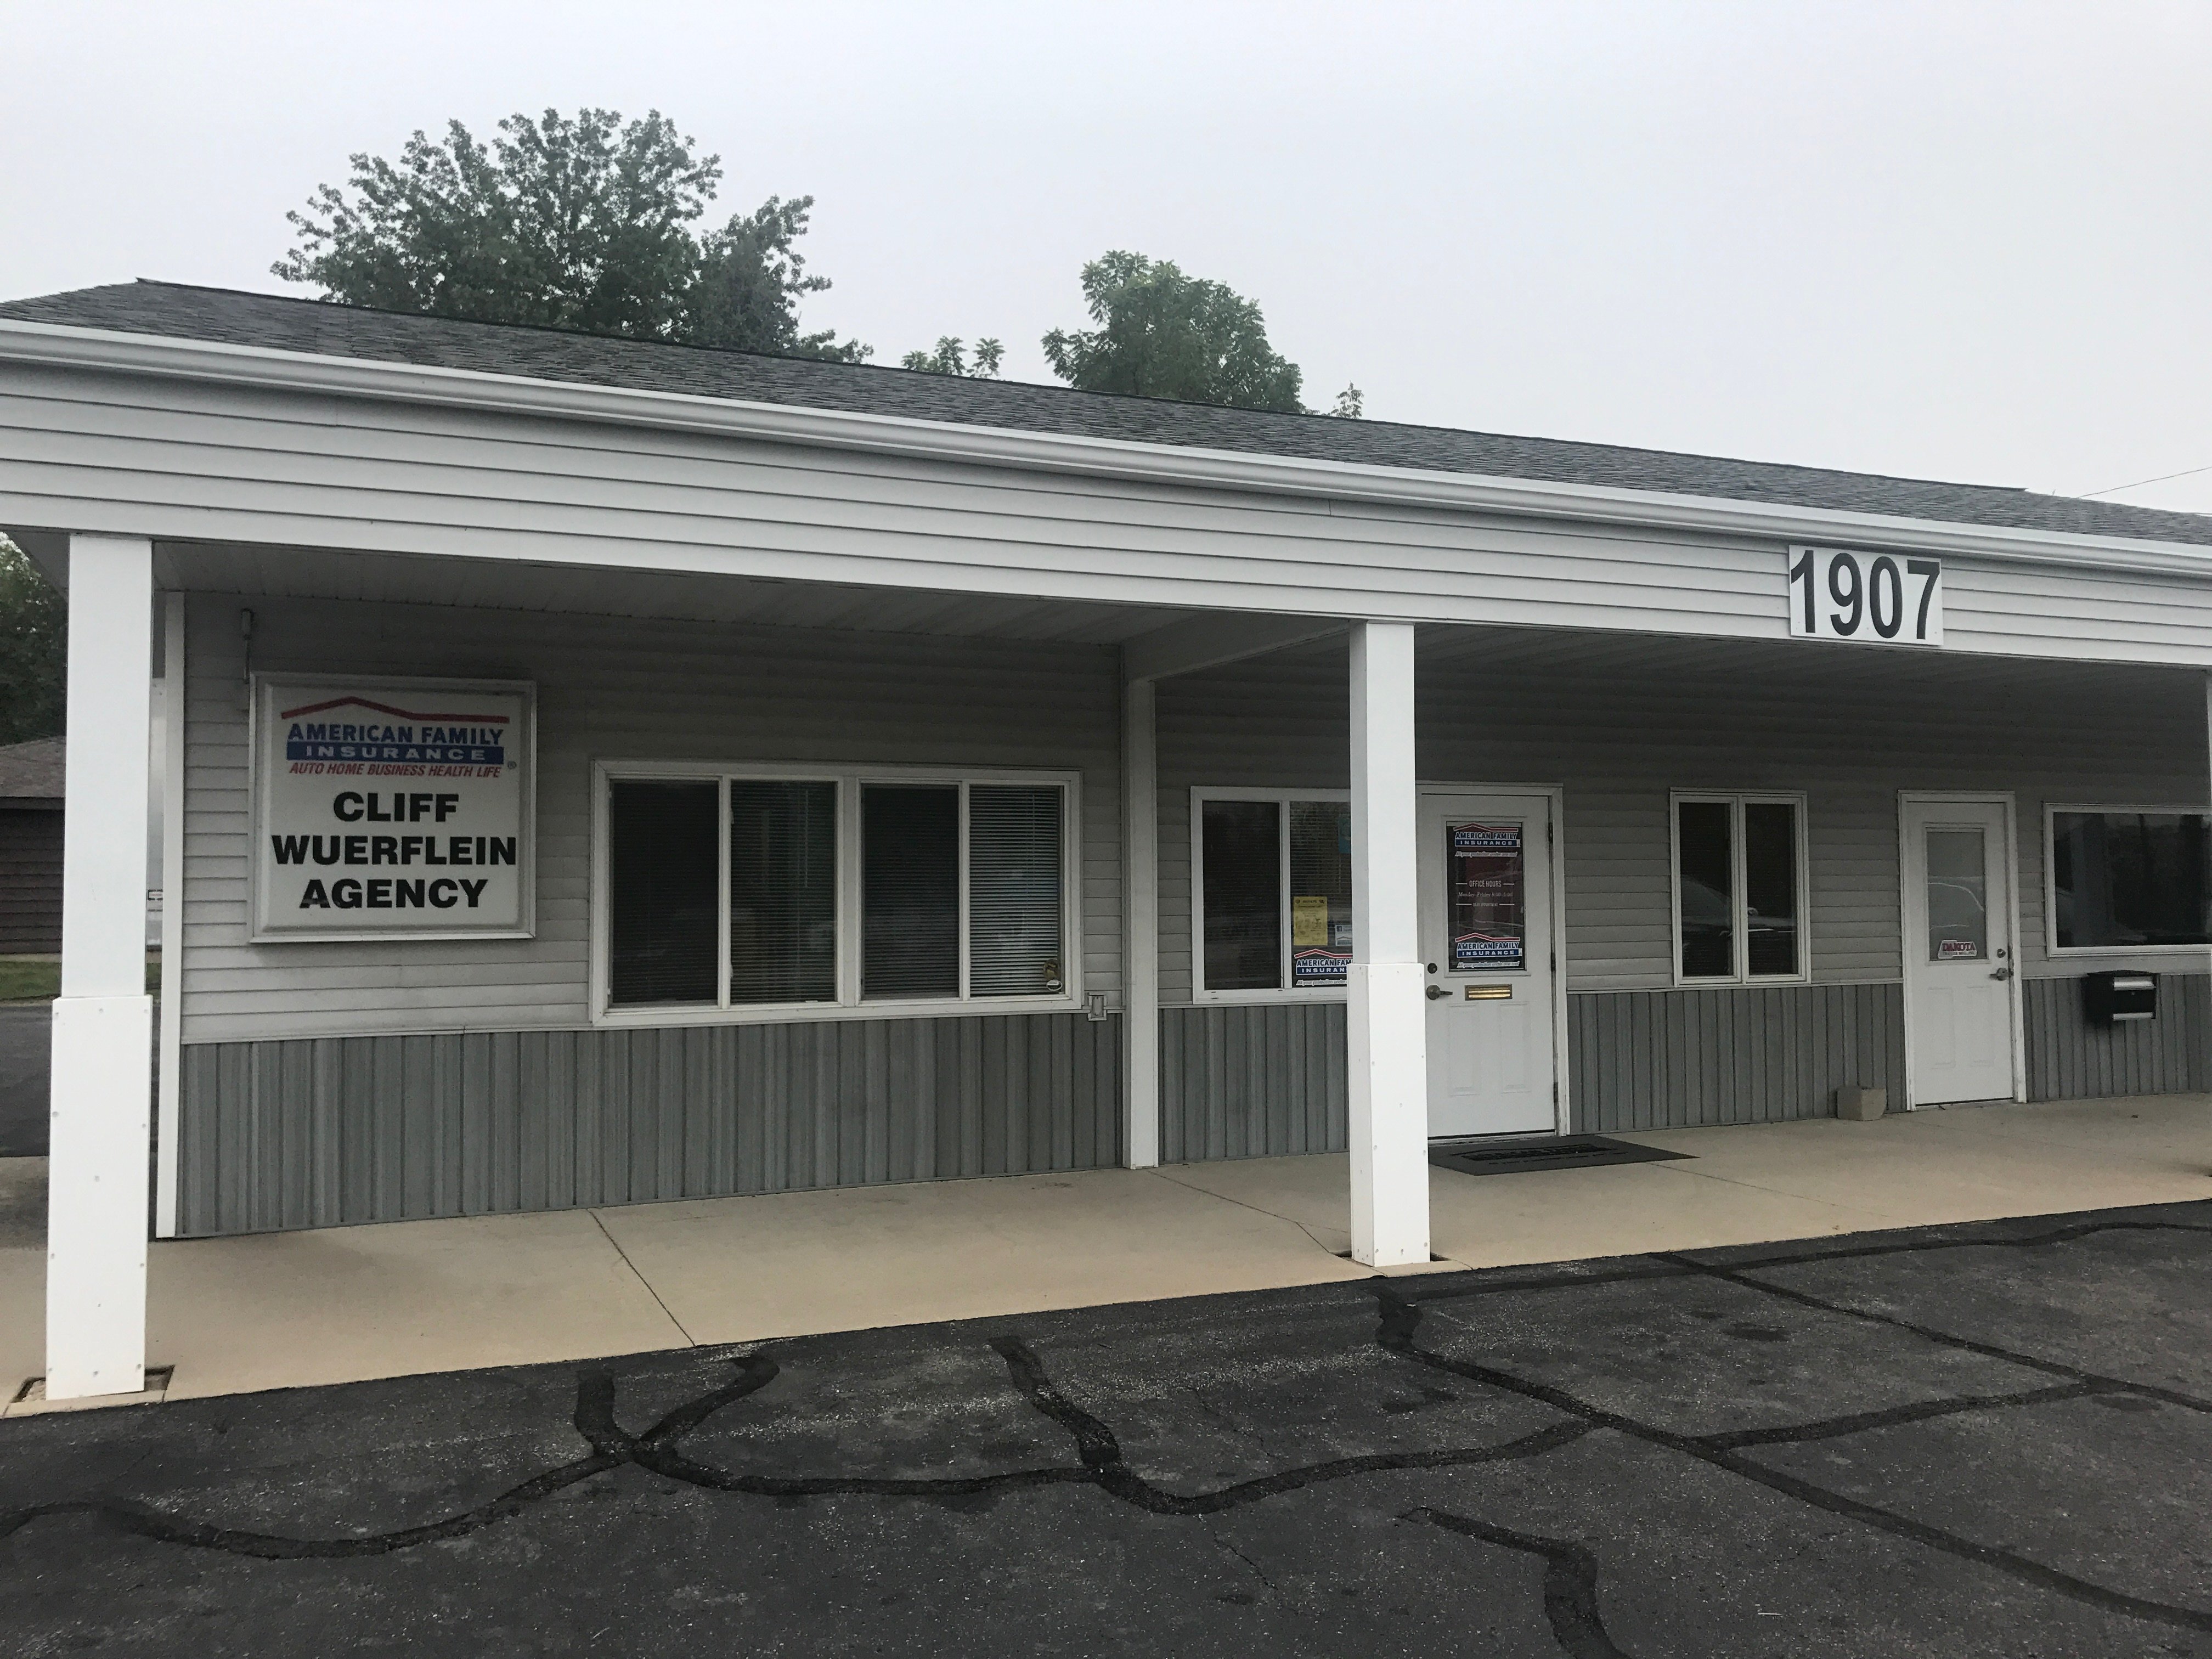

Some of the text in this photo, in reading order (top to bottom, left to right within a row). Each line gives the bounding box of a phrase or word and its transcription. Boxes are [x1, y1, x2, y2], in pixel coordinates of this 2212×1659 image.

[1791, 550, 1940, 640] 1907
[288, 723, 504, 745] AMERICAN FAMILY
[306, 745, 486, 760] INSURANCE
[289, 763, 501, 777] AUTO HOME BUSINESS HEALTH LIFE
[333, 792, 459, 822] CLIFF
[271, 835, 516, 865] WUERFLEIN
[299, 878, 488, 909] AGENCY
[1942, 943, 1976, 951] DAKOTA
